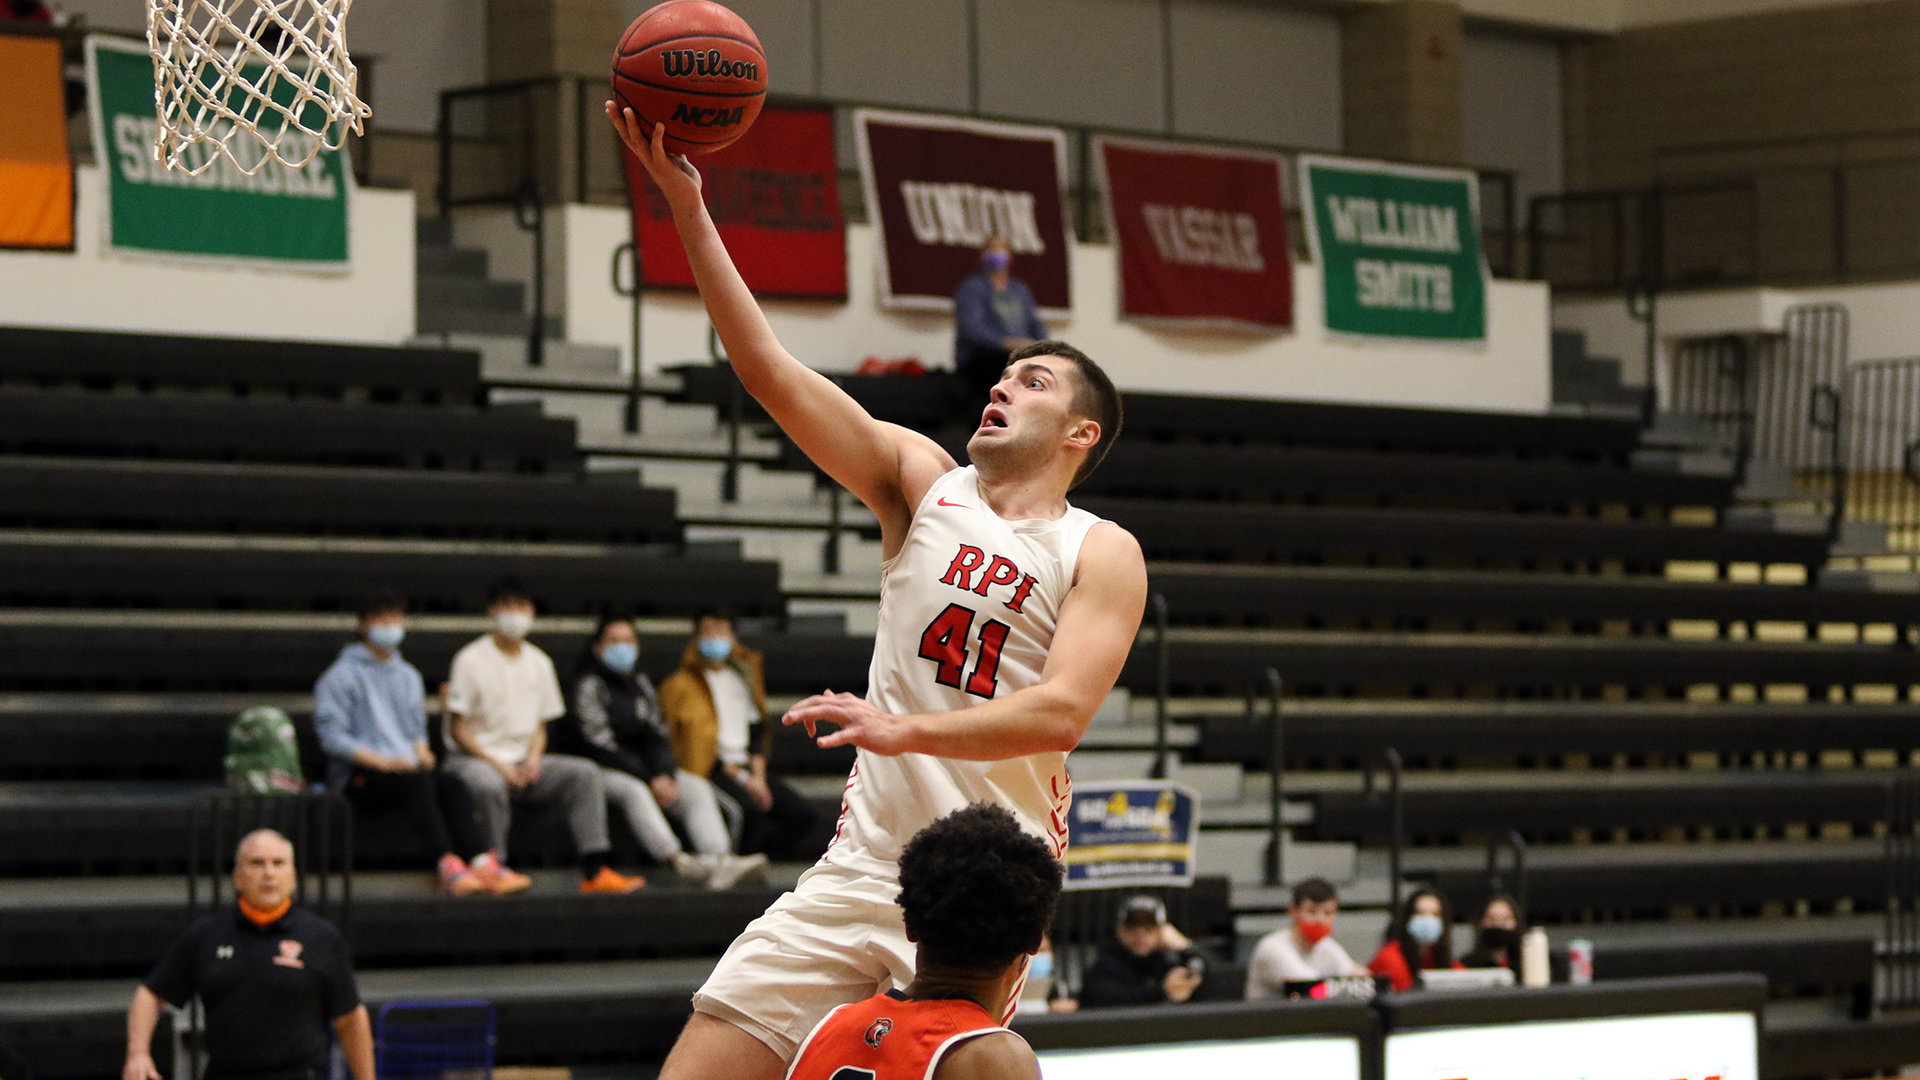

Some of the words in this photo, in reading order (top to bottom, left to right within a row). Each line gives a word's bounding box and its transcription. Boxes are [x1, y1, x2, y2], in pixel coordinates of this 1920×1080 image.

[660, 48, 759, 83] Wilson
[671, 103, 746, 128] NCAA
[901, 180, 1046, 255] UNION
[1142, 203, 1265, 272] VASSAR
[1327, 194, 1461, 253] WILLIAM
[1355, 259, 1454, 313] SMITH
[939, 543, 1040, 614] RPI
[918, 602, 1011, 699] 41
